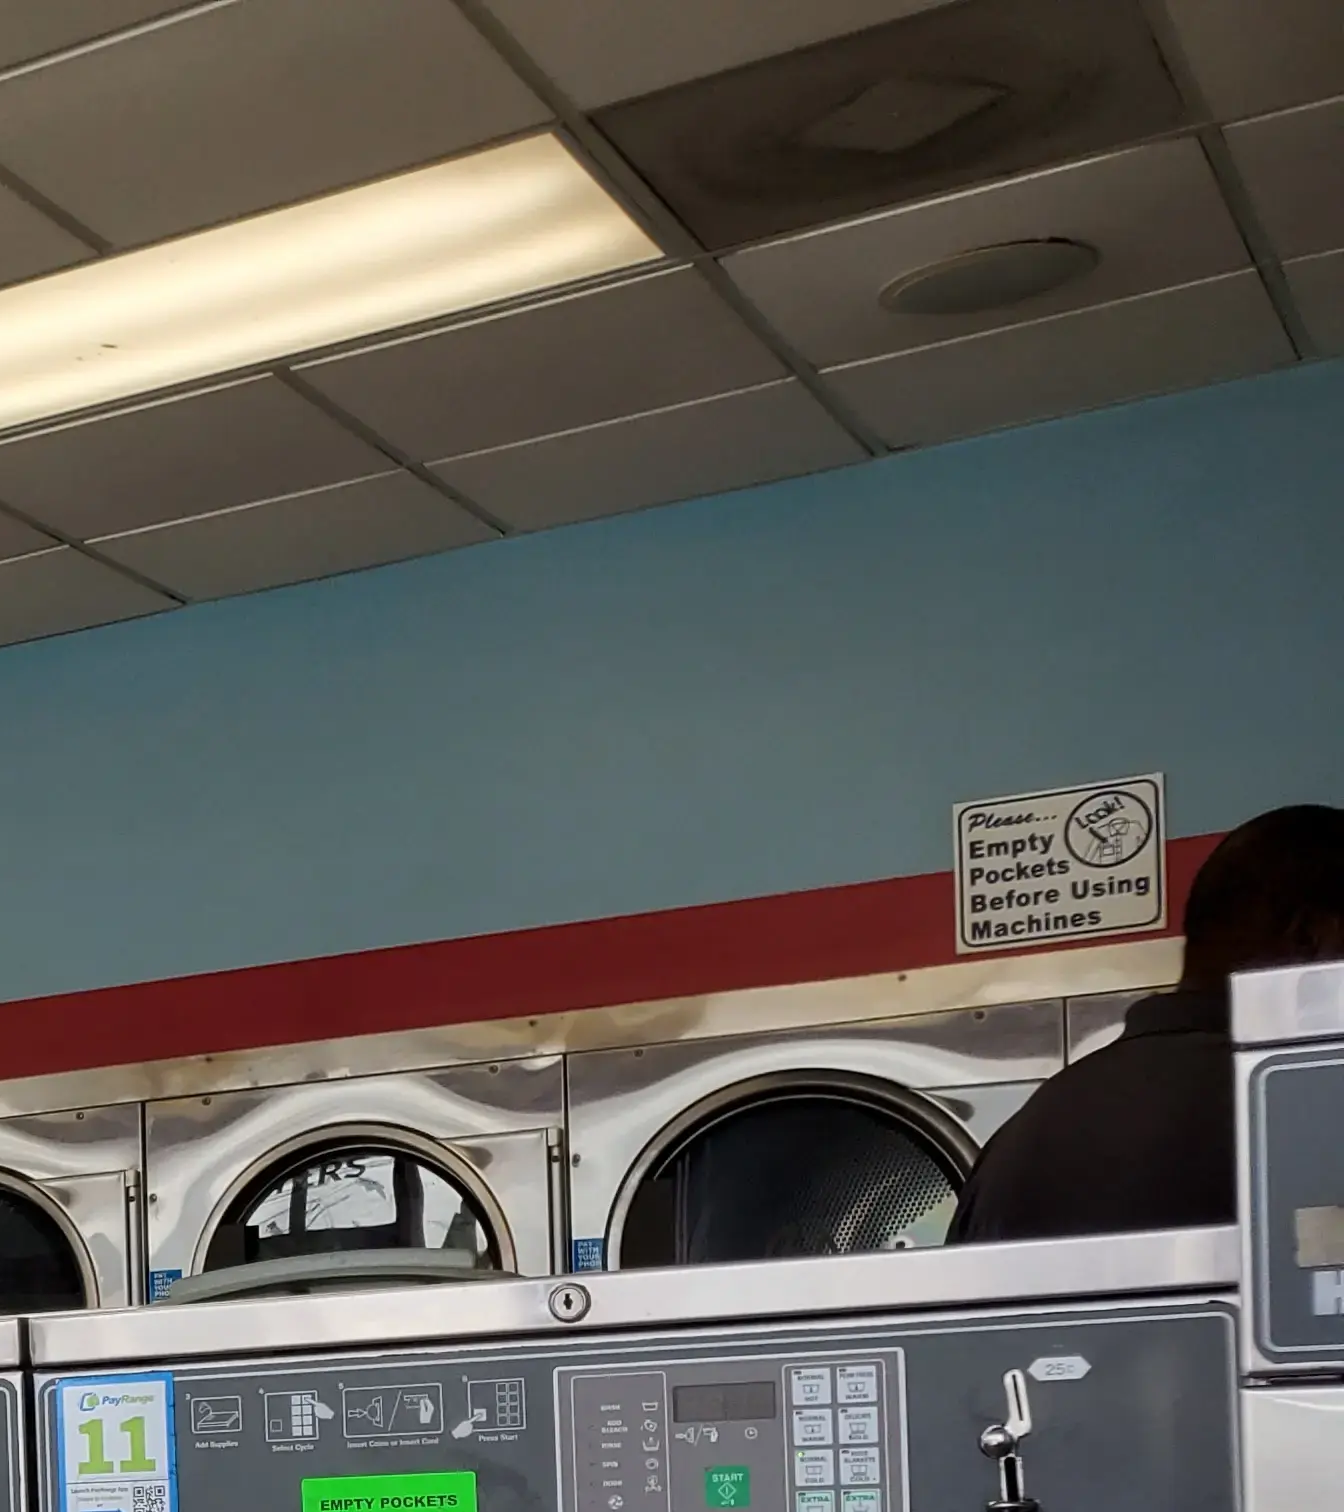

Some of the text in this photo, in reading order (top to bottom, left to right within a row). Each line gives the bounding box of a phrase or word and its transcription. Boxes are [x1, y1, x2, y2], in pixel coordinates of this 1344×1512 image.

[969, 833, 1055, 859] Empty
[969, 858, 1071, 886] Pockets
[970, 875, 1151, 914] Before Using
[971, 910, 1102, 941] Machines
[102, 1394, 154, 1408] PayRange
[78, 1416, 156, 1474] 11
[712, 1474, 743, 1482] START
[320, 1494, 458, 1512] EMPTY POCKETS
